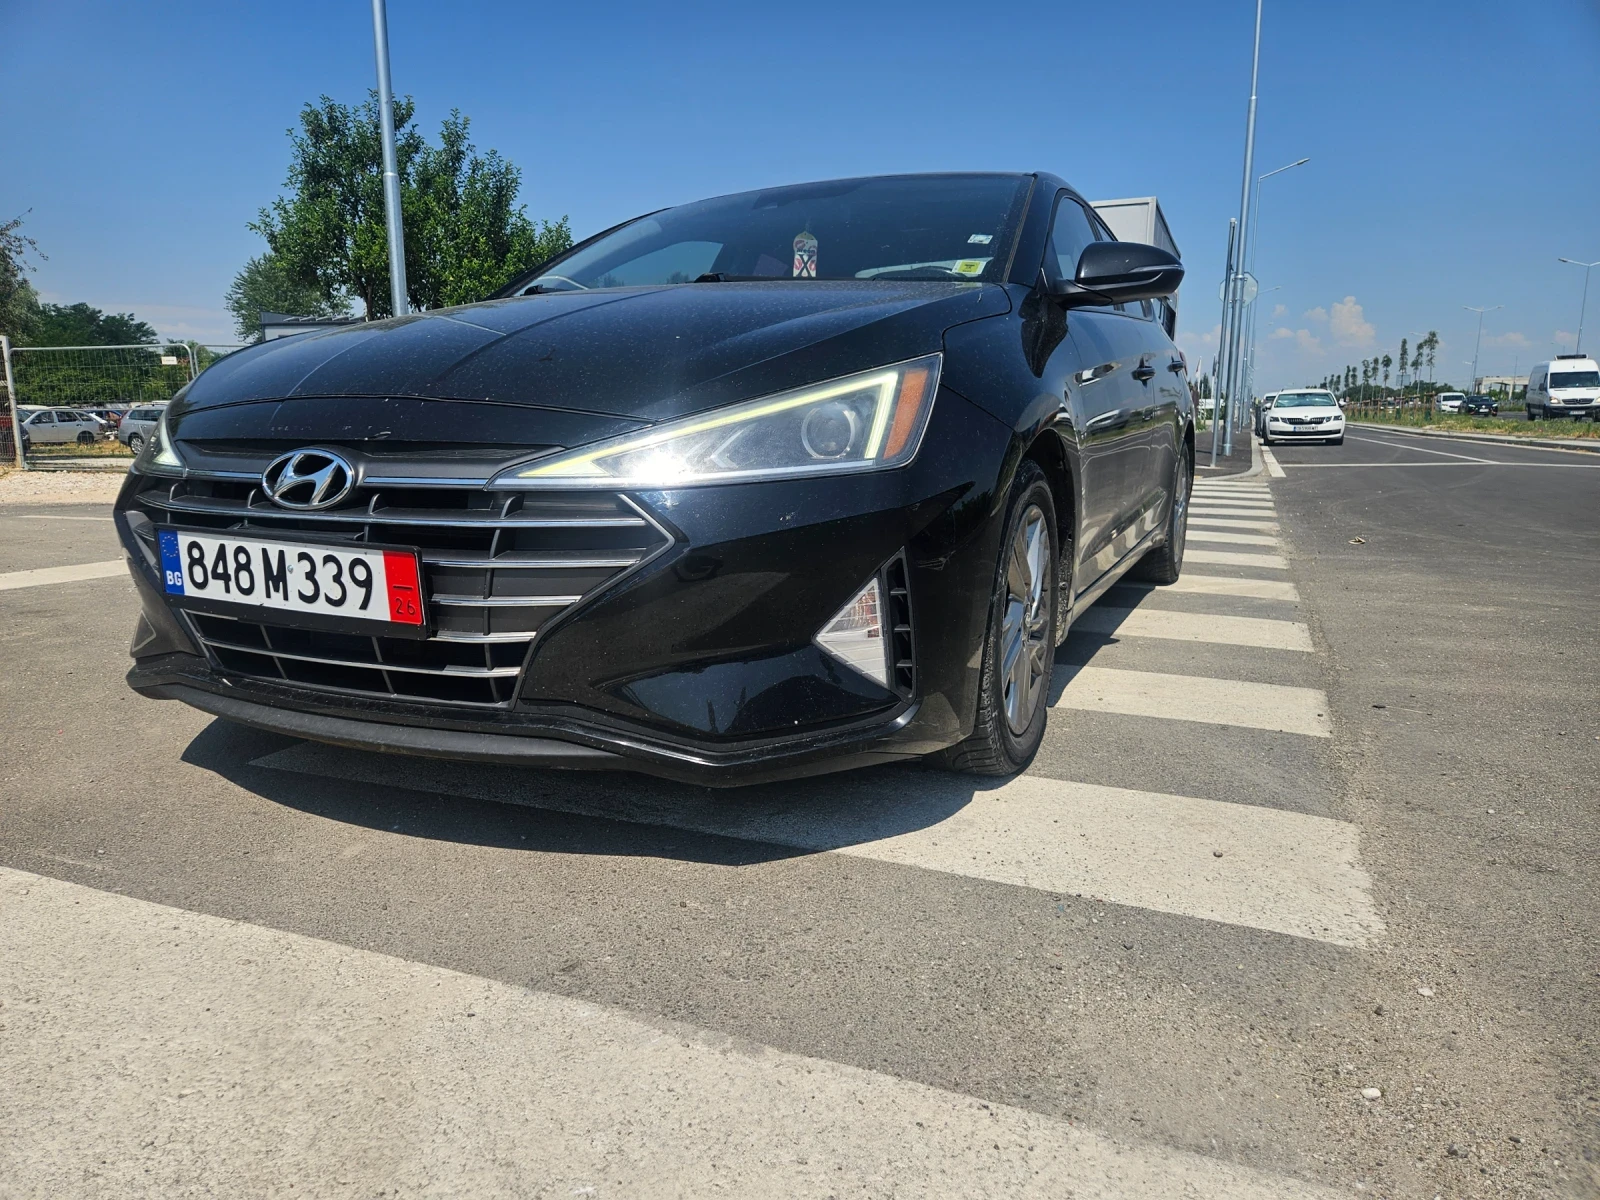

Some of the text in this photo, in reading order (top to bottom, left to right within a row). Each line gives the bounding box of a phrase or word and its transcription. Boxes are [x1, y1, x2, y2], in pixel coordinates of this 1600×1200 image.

[166, 570, 182, 586] BG
[187, 541, 373, 610] 848 M 339
[395, 597, 416, 616] 26
